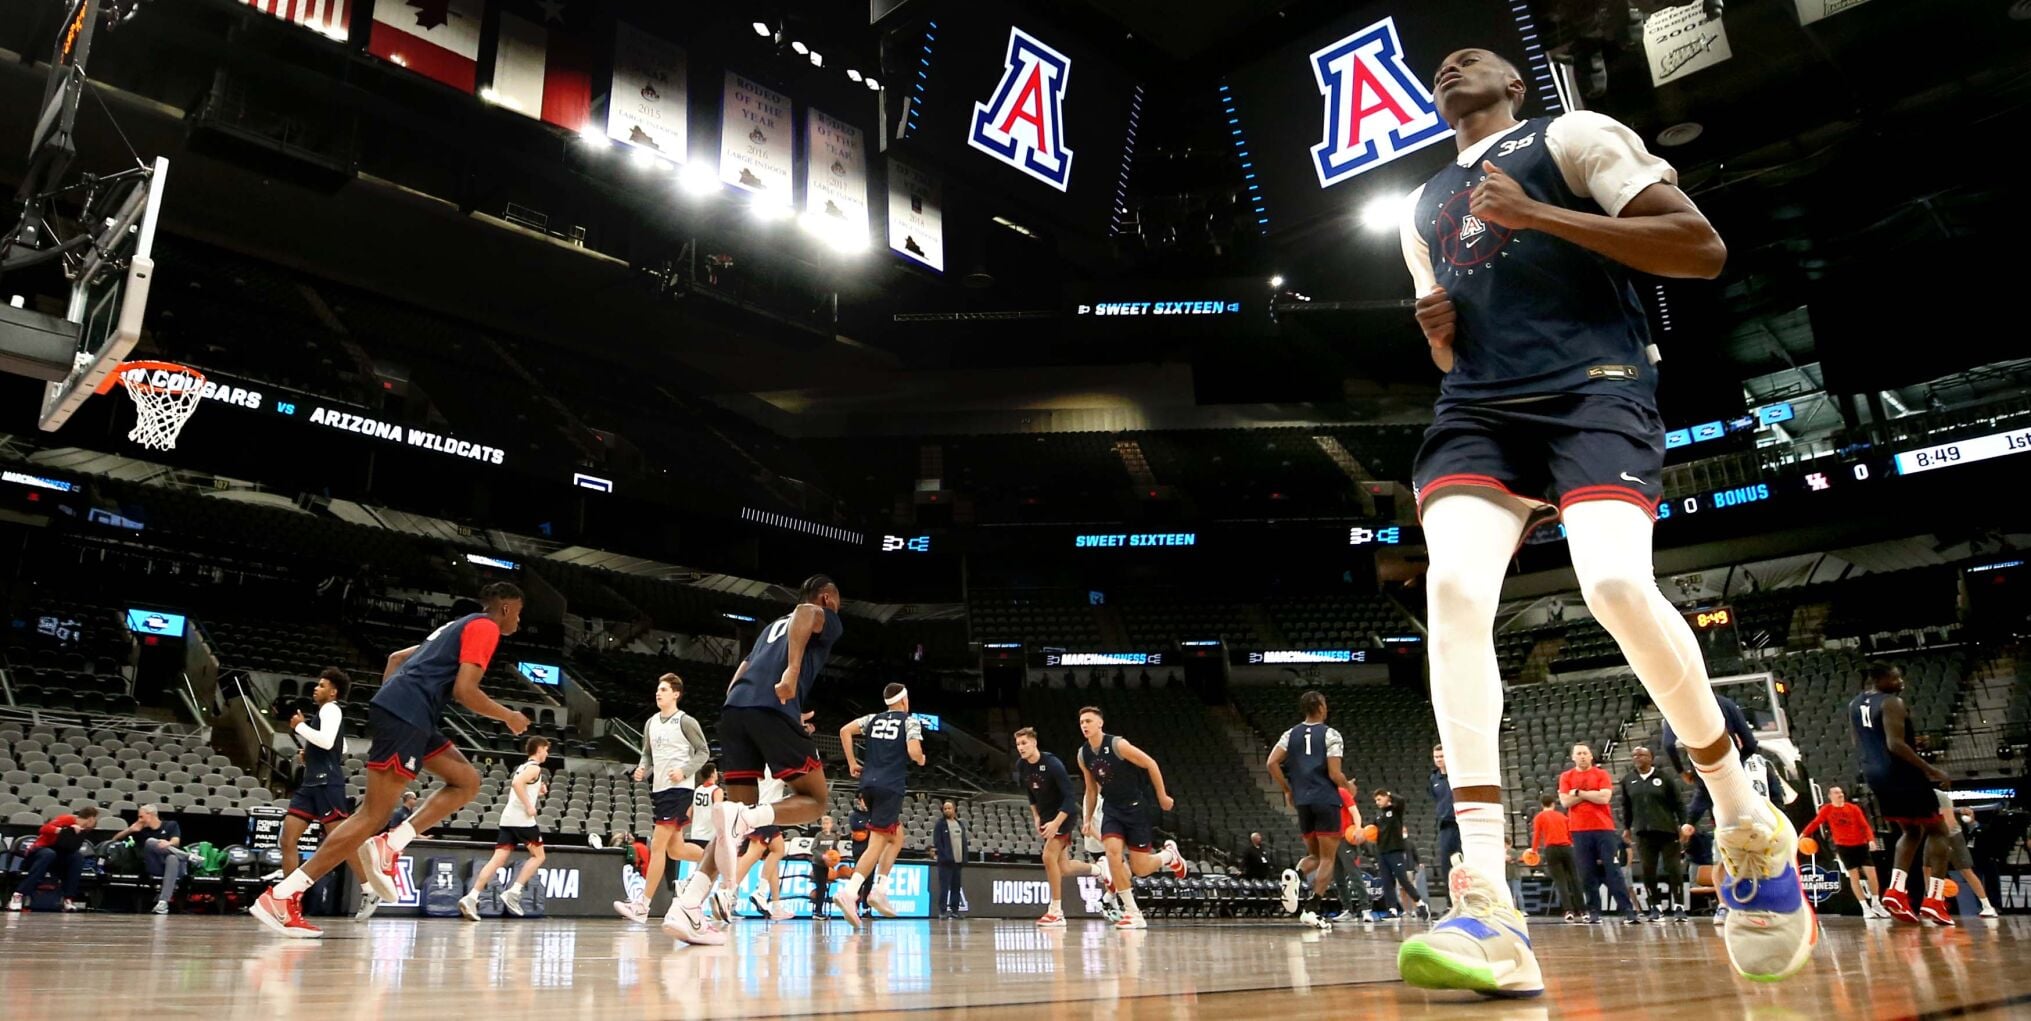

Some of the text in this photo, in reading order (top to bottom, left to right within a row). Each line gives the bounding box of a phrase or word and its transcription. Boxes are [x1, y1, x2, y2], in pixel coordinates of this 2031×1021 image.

[736, 78, 781, 103] RODEO
[638, 103, 661, 119] 2015
[735, 92, 783, 117] OF THE
[968, 26, 1073, 193] A
[1310, 16, 1457, 188] A
[742, 108, 775, 128] YEAR
[747, 145, 768, 160] 2016
[1498, 132, 1537, 157] 35
[1095, 301, 1224, 315] SWEET SIXTEEN
[152, 369, 263, 409] COUGARS
[277, 402, 295, 415] VS
[310, 407, 402, 442] ARIZONA
[407, 428, 505, 464] WILDCATS
[1917, 447, 1961, 467] 8:49
[1854, 464, 1869, 480] 0
[1684, 498, 1698, 514] 0
[1714, 484, 1769, 508] BONUS
[1076, 534, 1195, 547] SWEET SIXTEEN
[1697, 610, 1728, 627] 8:49
[871, 719, 901, 740] 25
[1103, 746, 1110, 754] 3
[1304, 733, 1312, 755] 1
[695, 792, 710, 807] 50
[993, 881, 1050, 904] HOUSTO
